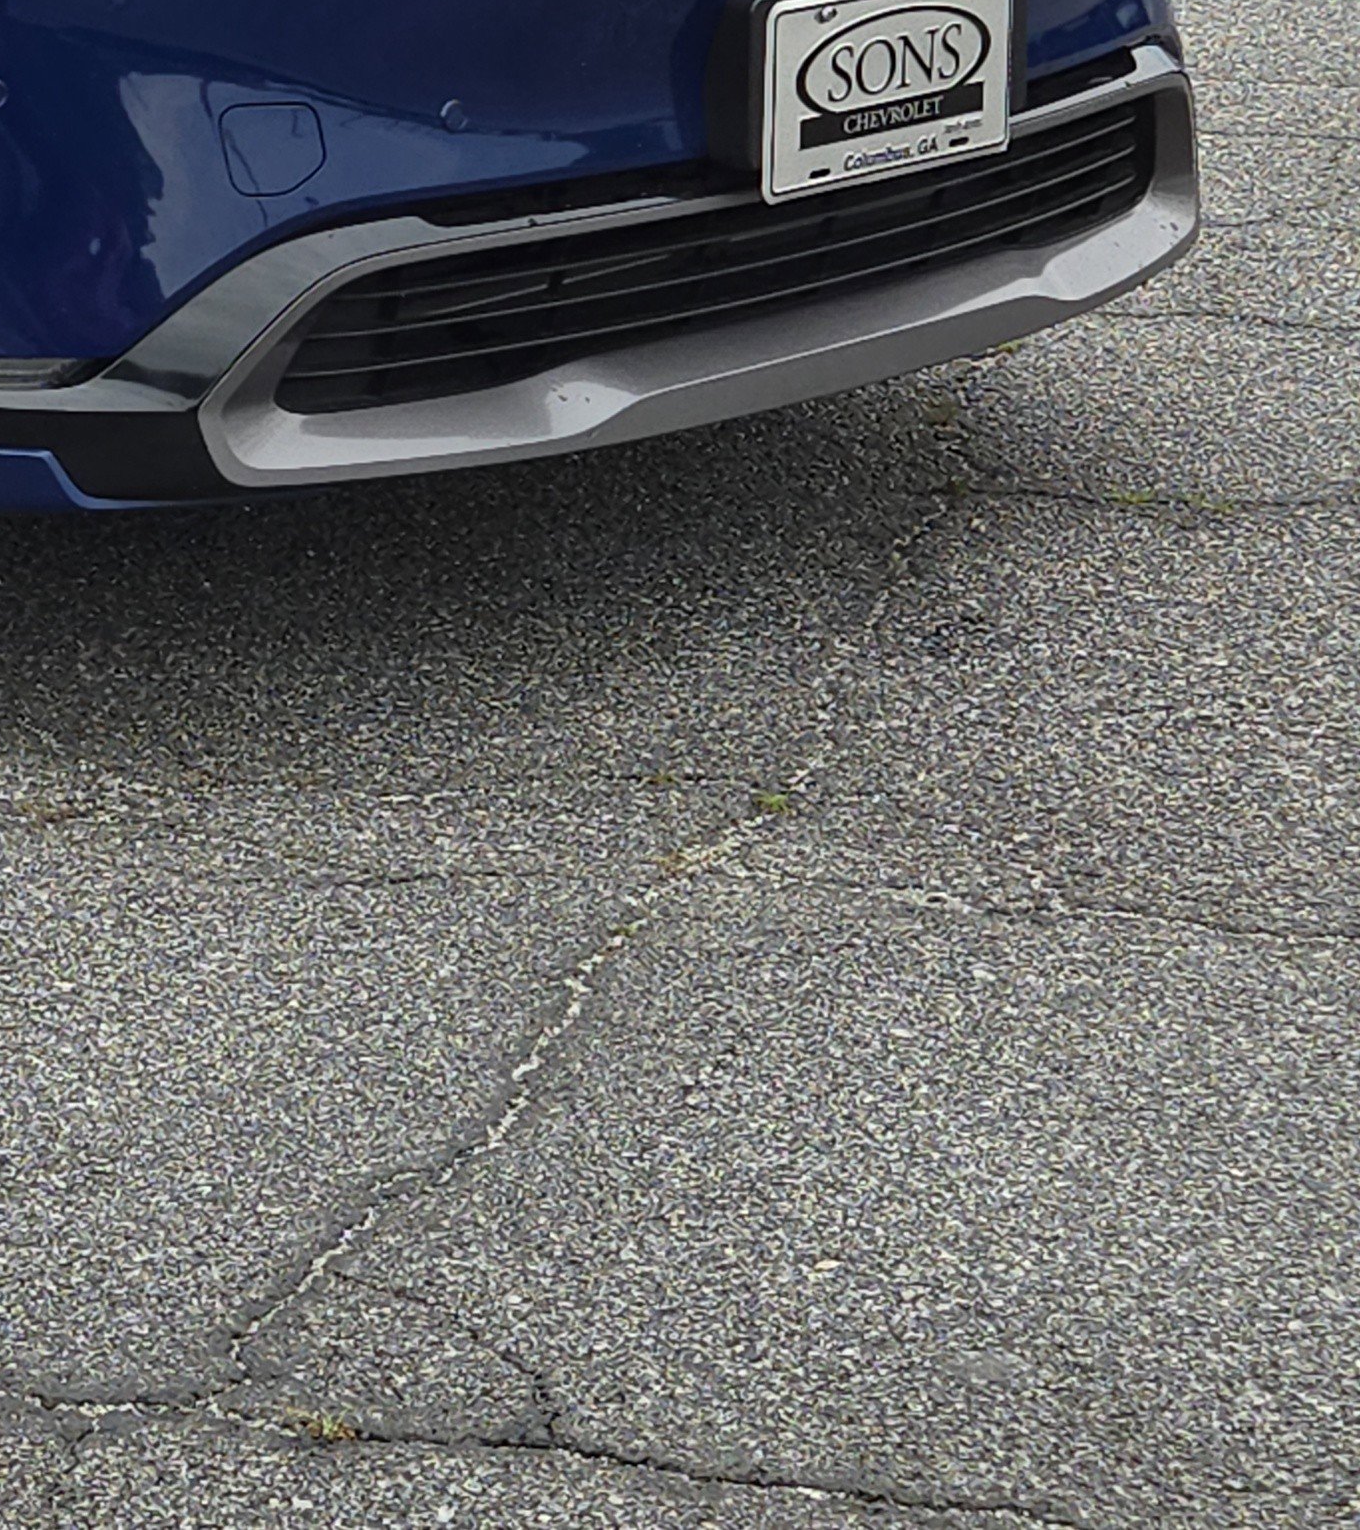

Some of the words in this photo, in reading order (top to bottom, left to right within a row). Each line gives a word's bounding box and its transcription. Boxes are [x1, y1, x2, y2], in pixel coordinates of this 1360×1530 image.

[827, 22, 962, 103] SONS
[843, 94, 944, 135] CHEVROLET
[918, 136, 939, 155] GA
